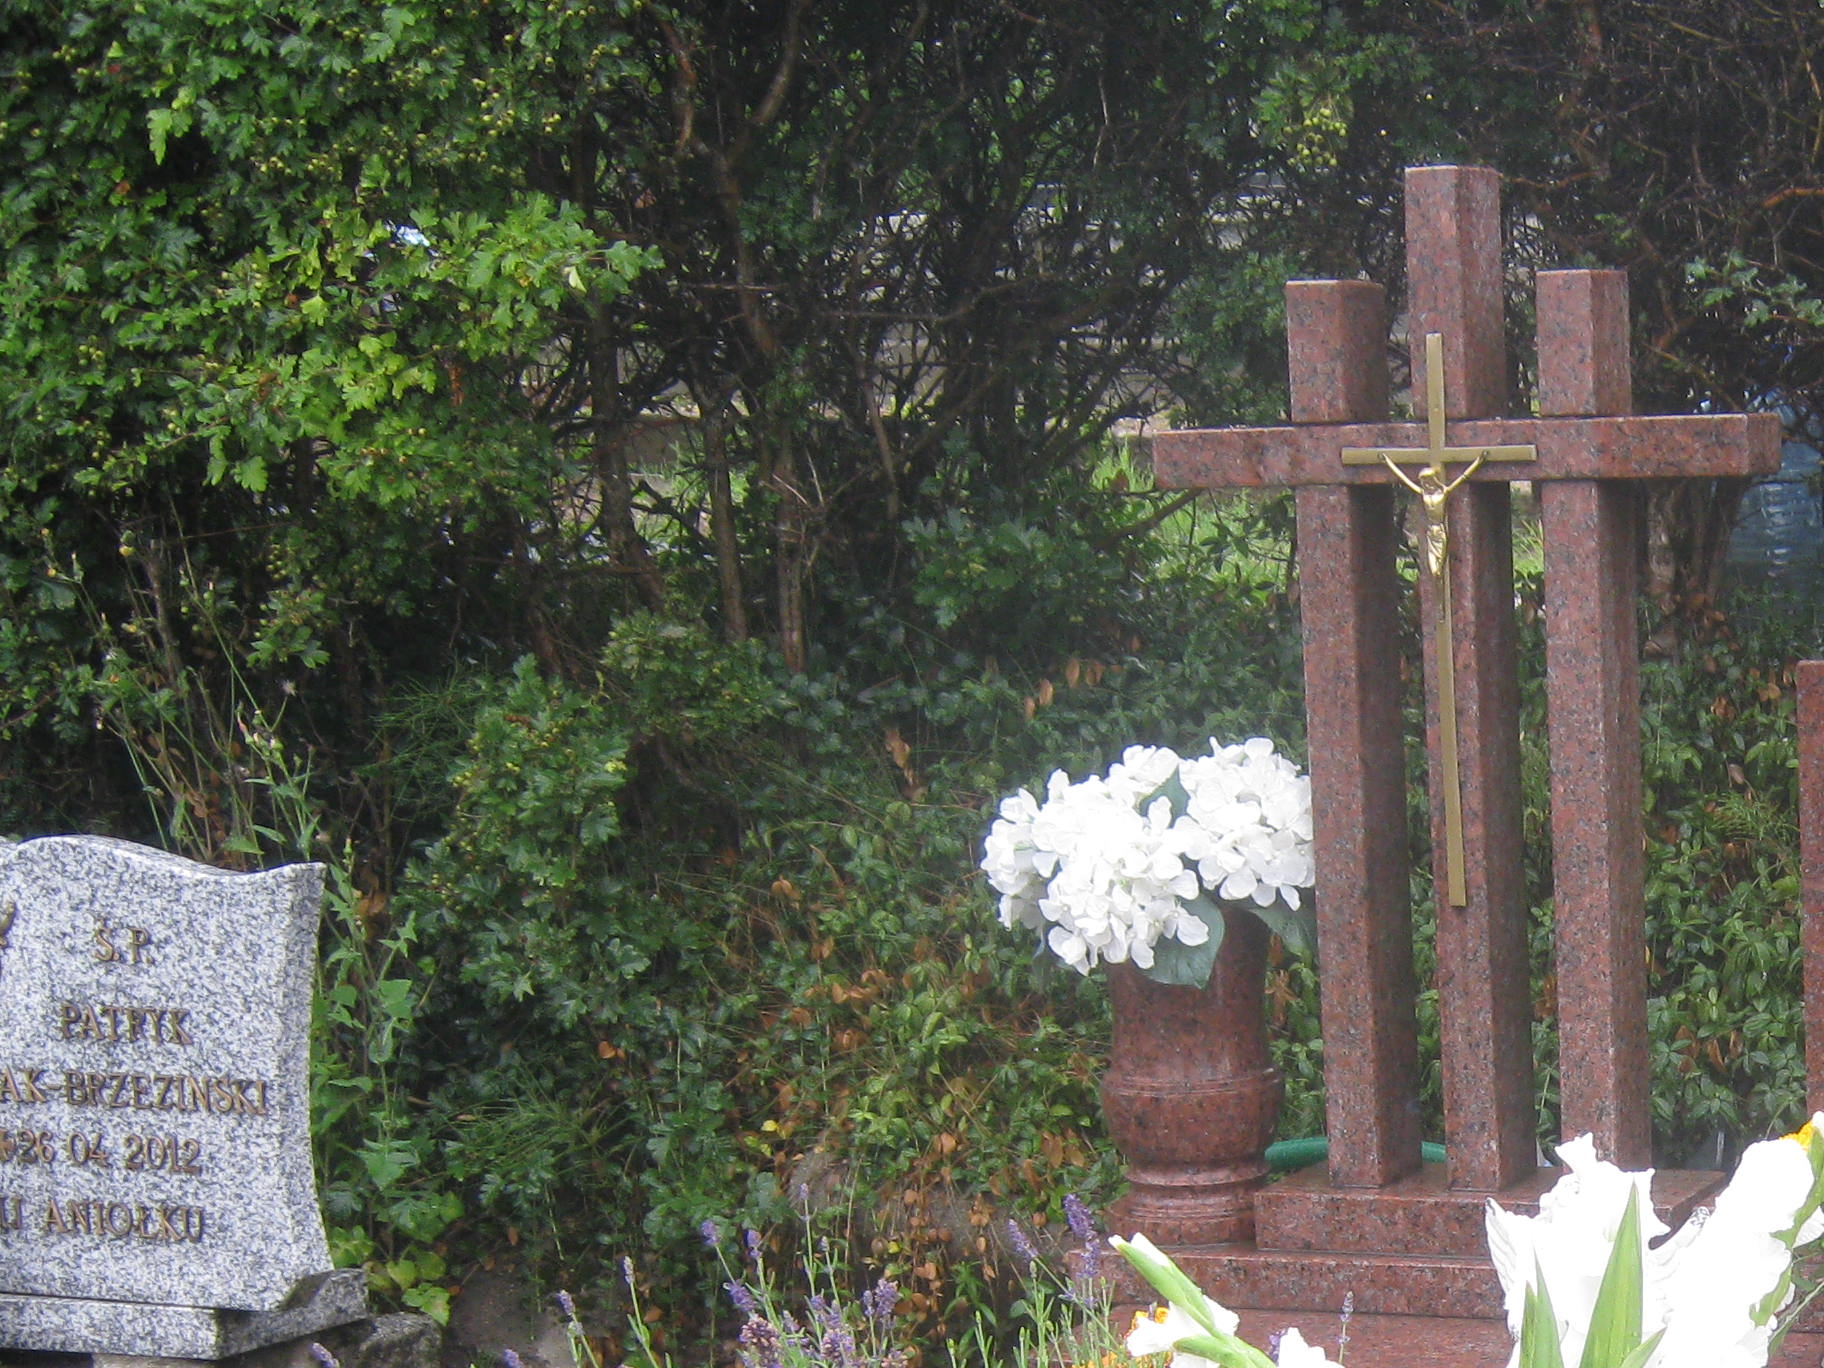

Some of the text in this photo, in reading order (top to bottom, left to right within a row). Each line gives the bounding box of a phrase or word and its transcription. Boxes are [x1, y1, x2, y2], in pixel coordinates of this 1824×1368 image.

[59, 1002, 194, 1046] PATRYK
[17, 1128, 201, 1175] 26 04 2012
[45, 1198, 203, 1243] ANIOŁKU
